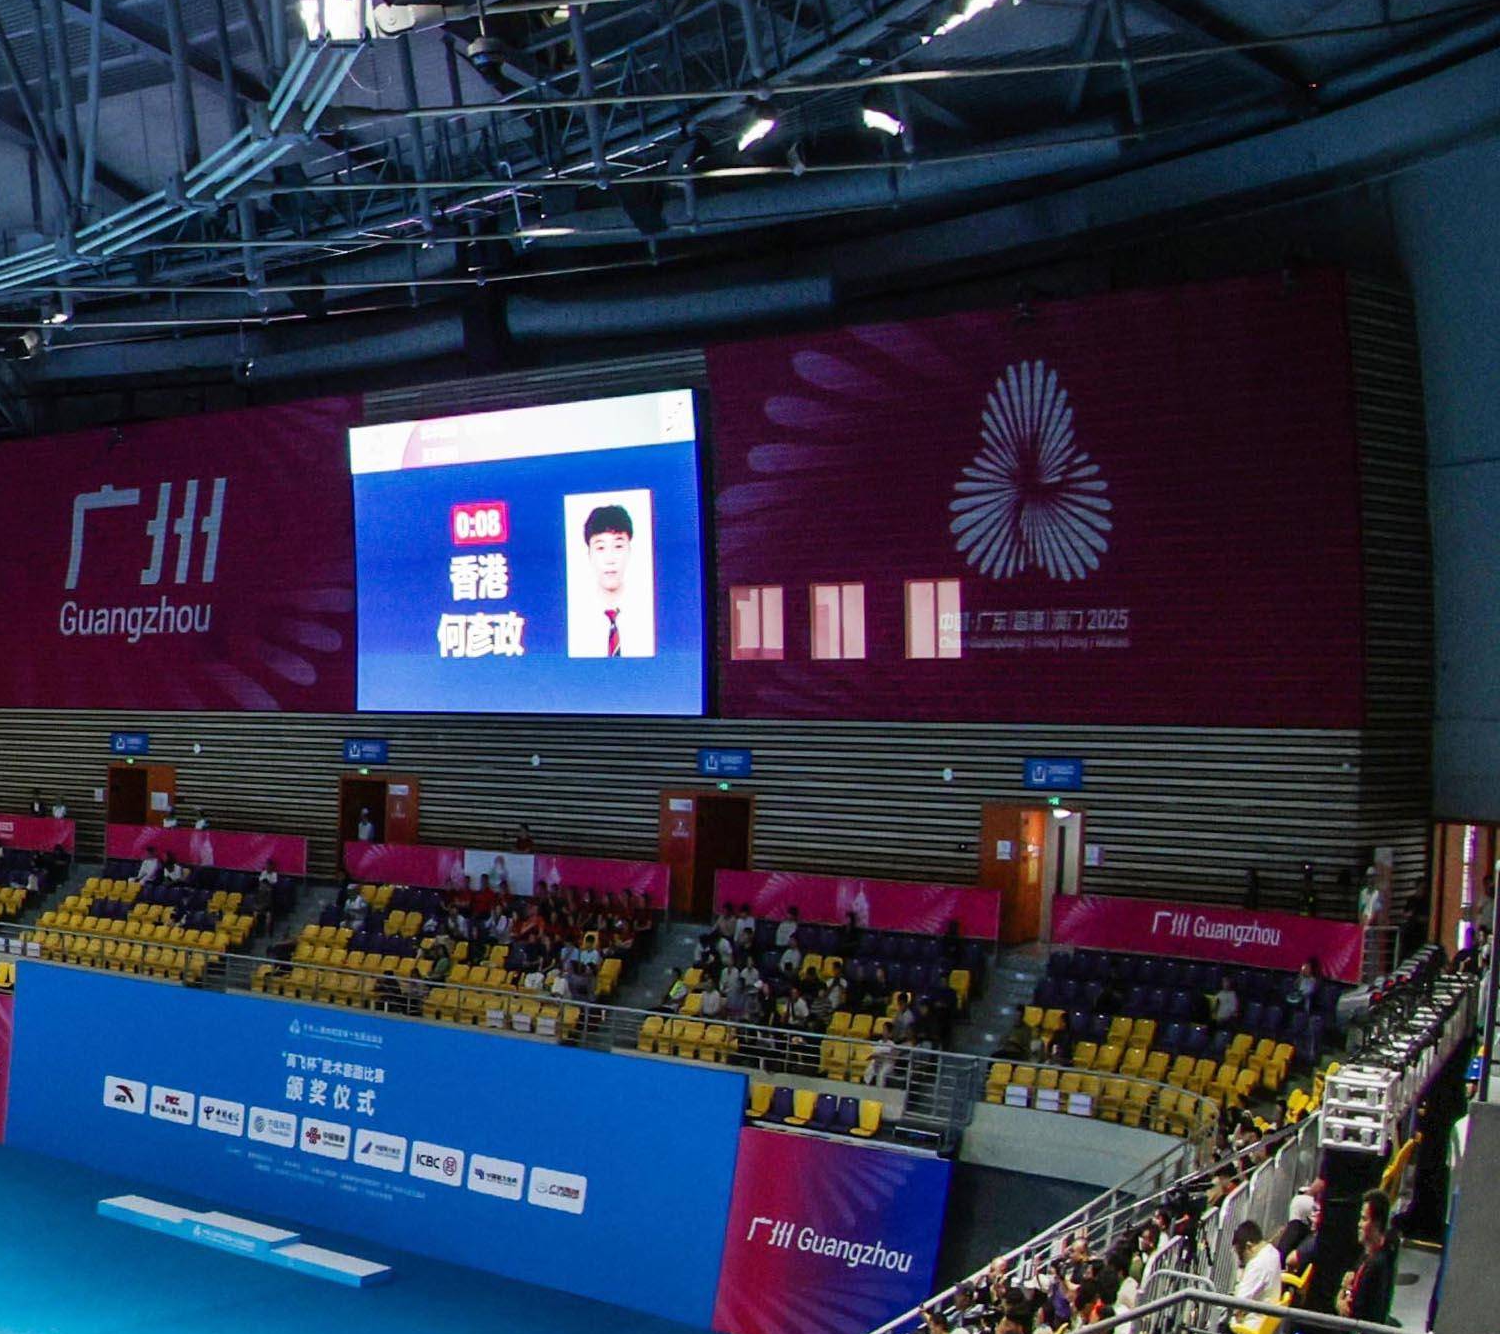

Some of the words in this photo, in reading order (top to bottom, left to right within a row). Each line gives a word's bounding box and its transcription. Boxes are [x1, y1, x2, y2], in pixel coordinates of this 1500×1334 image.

[64, 477, 227, 590] 广州
[455, 509, 500, 538] 0:08
[450, 553, 508, 601] 香港
[60, 595, 211, 643] Guangzhou
[1087, 609, 1129, 630] 2025
[1194, 916, 1280, 947] Guangzhou
[286, 1075, 376, 1116] 颁奖仪式
[416, 1153, 440, 1170] ICBC
[747, 1216, 795, 1249] 广州
[797, 1226, 913, 1273] Guangzhou
